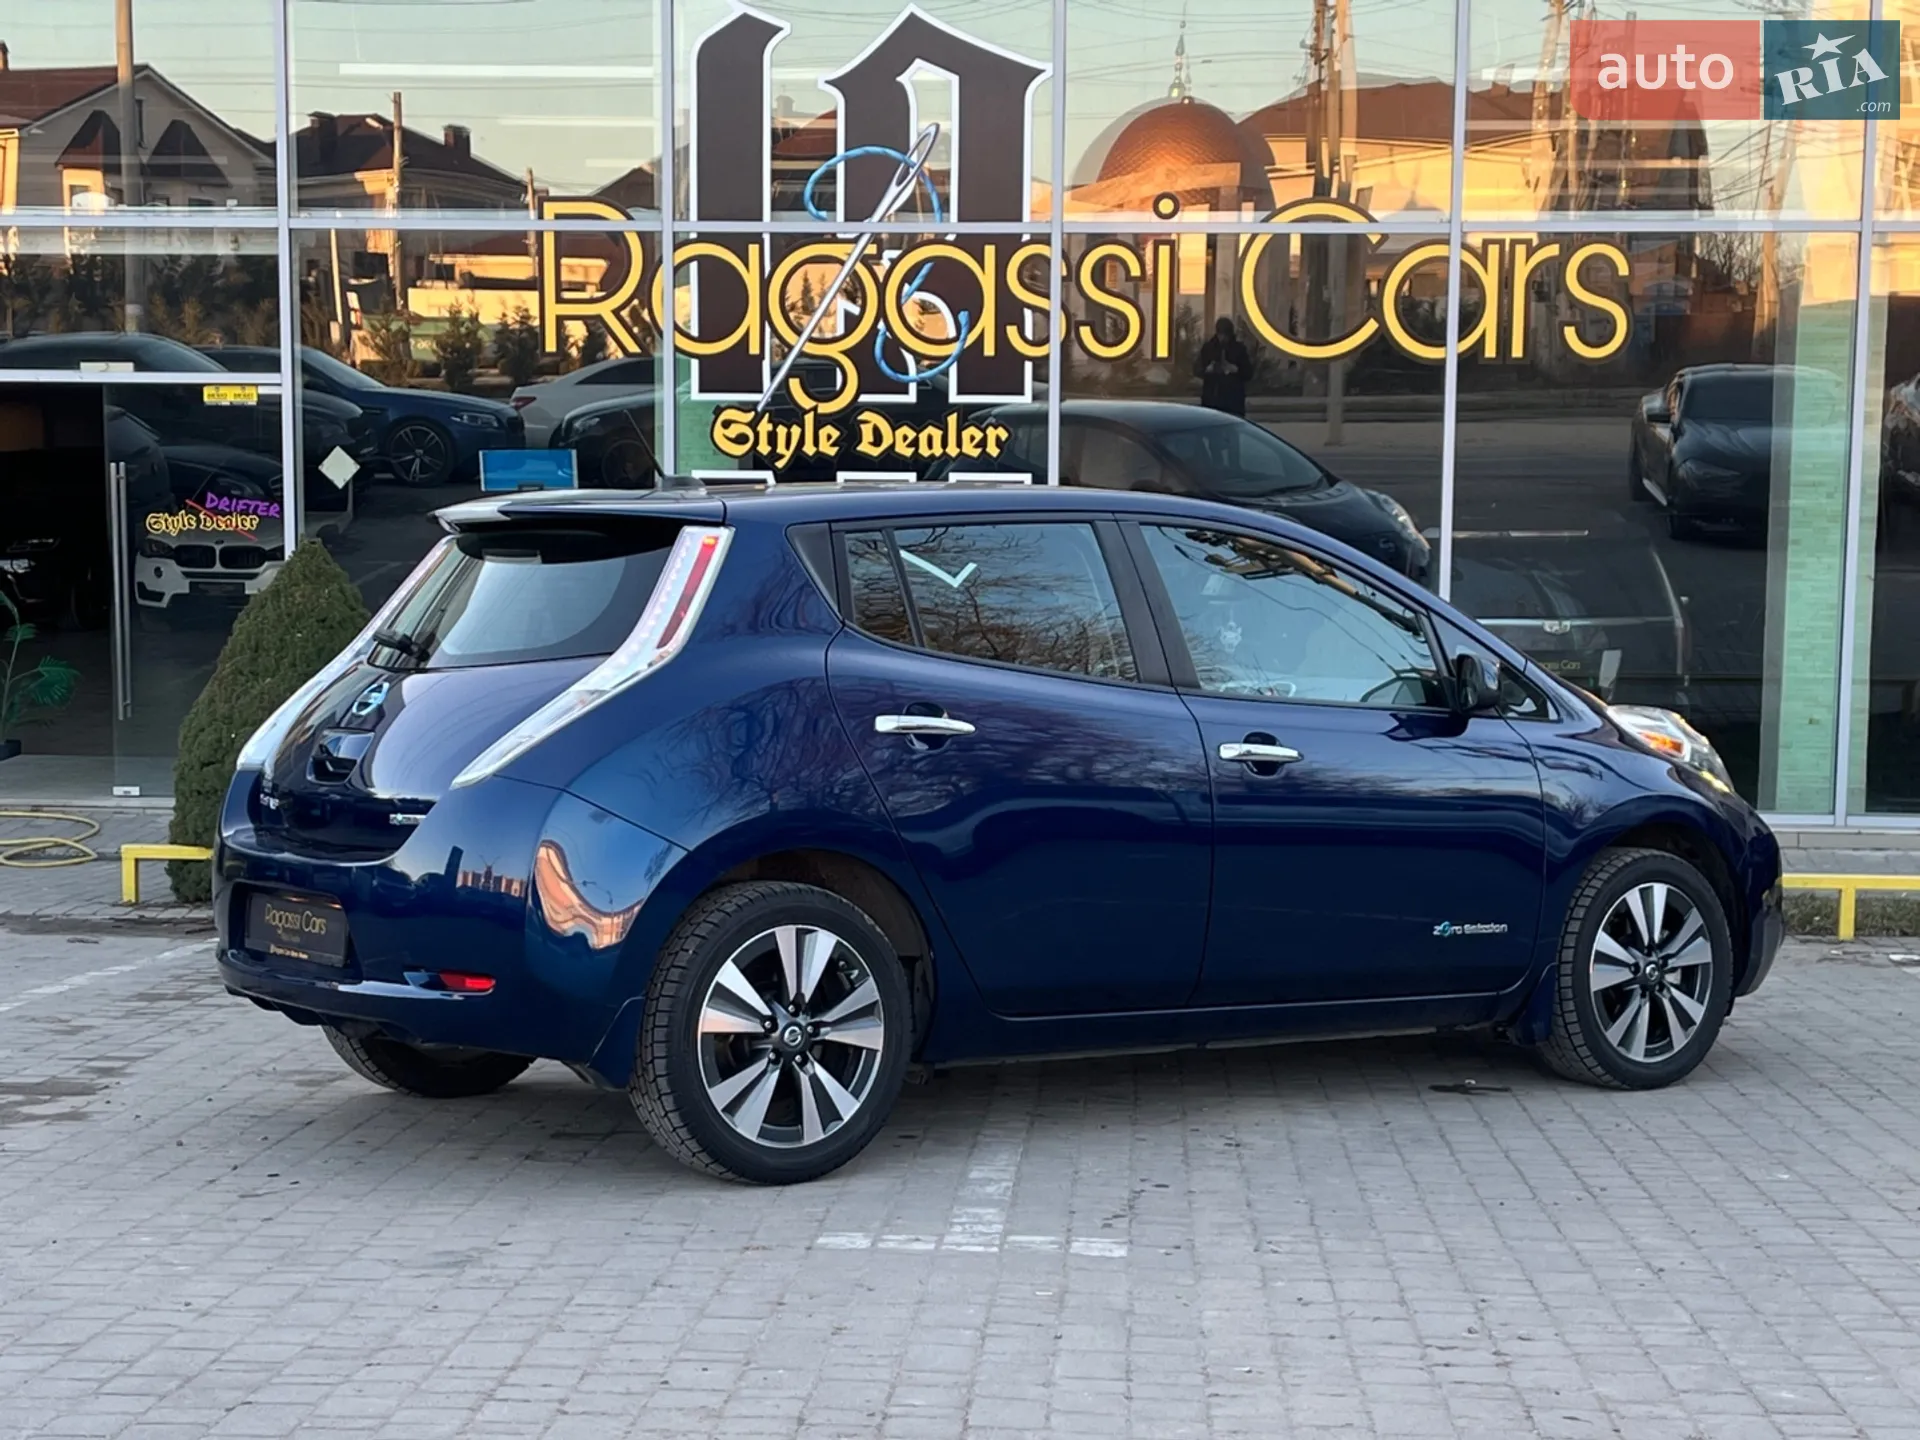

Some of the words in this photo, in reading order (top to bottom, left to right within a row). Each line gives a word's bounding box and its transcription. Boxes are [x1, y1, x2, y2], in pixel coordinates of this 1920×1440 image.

[541, 195, 1177, 415] Ragassi
[1240, 202, 1631, 360] Cars
[712, 407, 842, 470] Style
[857, 410, 1009, 459] Dealer
[205, 491, 281, 518] DRIFTER
[146, 510, 196, 536] Style
[199, 511, 259, 531] Dealer
[302, 910, 327, 935] Cars
